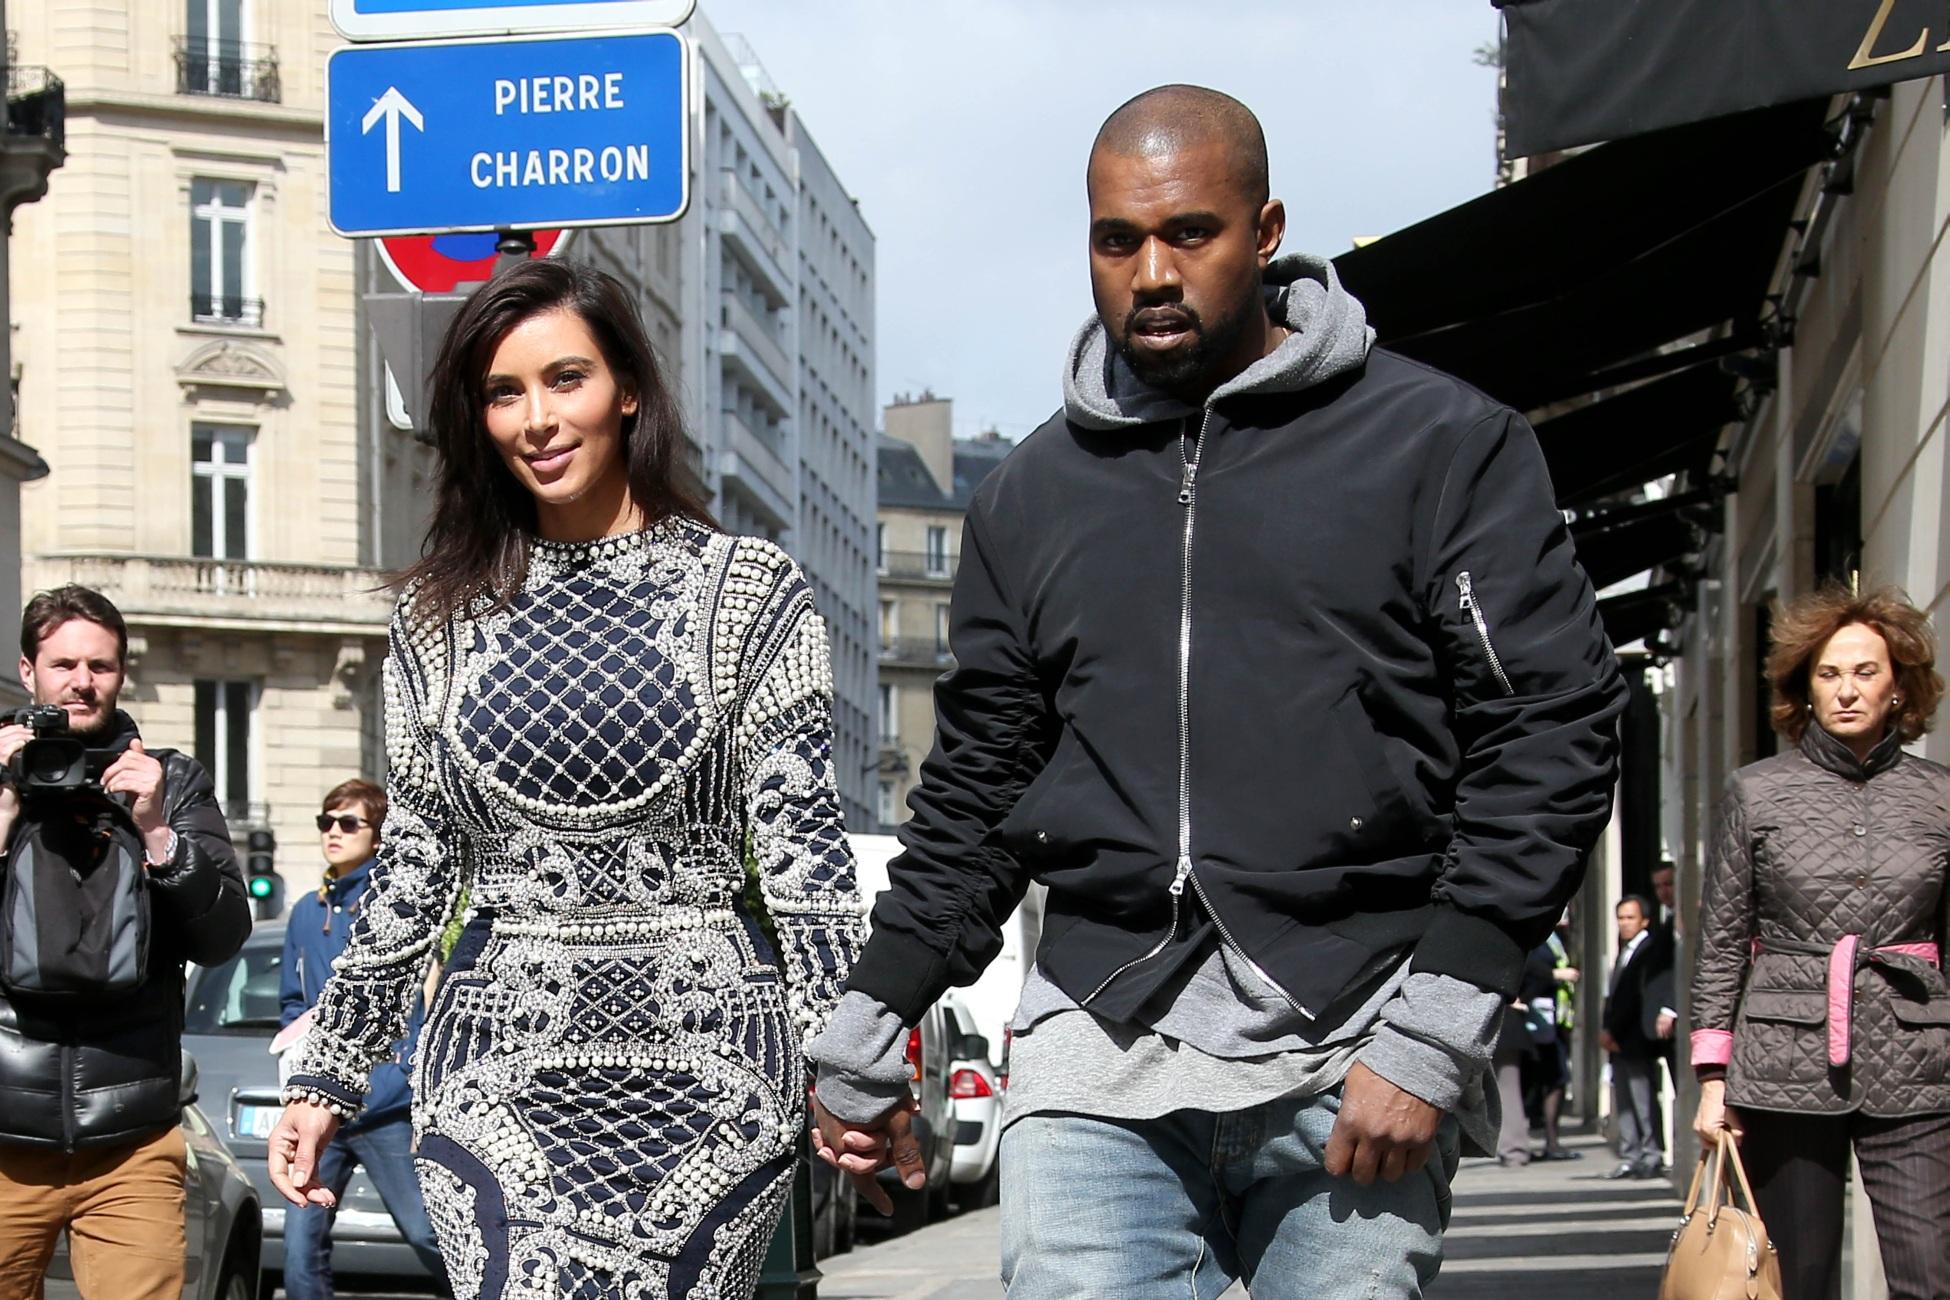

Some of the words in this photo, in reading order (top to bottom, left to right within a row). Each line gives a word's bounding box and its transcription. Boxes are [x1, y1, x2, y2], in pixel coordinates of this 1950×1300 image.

[1847, 0, 1950, 70] Z
[494, 72, 624, 115] PIERRE
[470, 144, 649, 188] CHARRON
